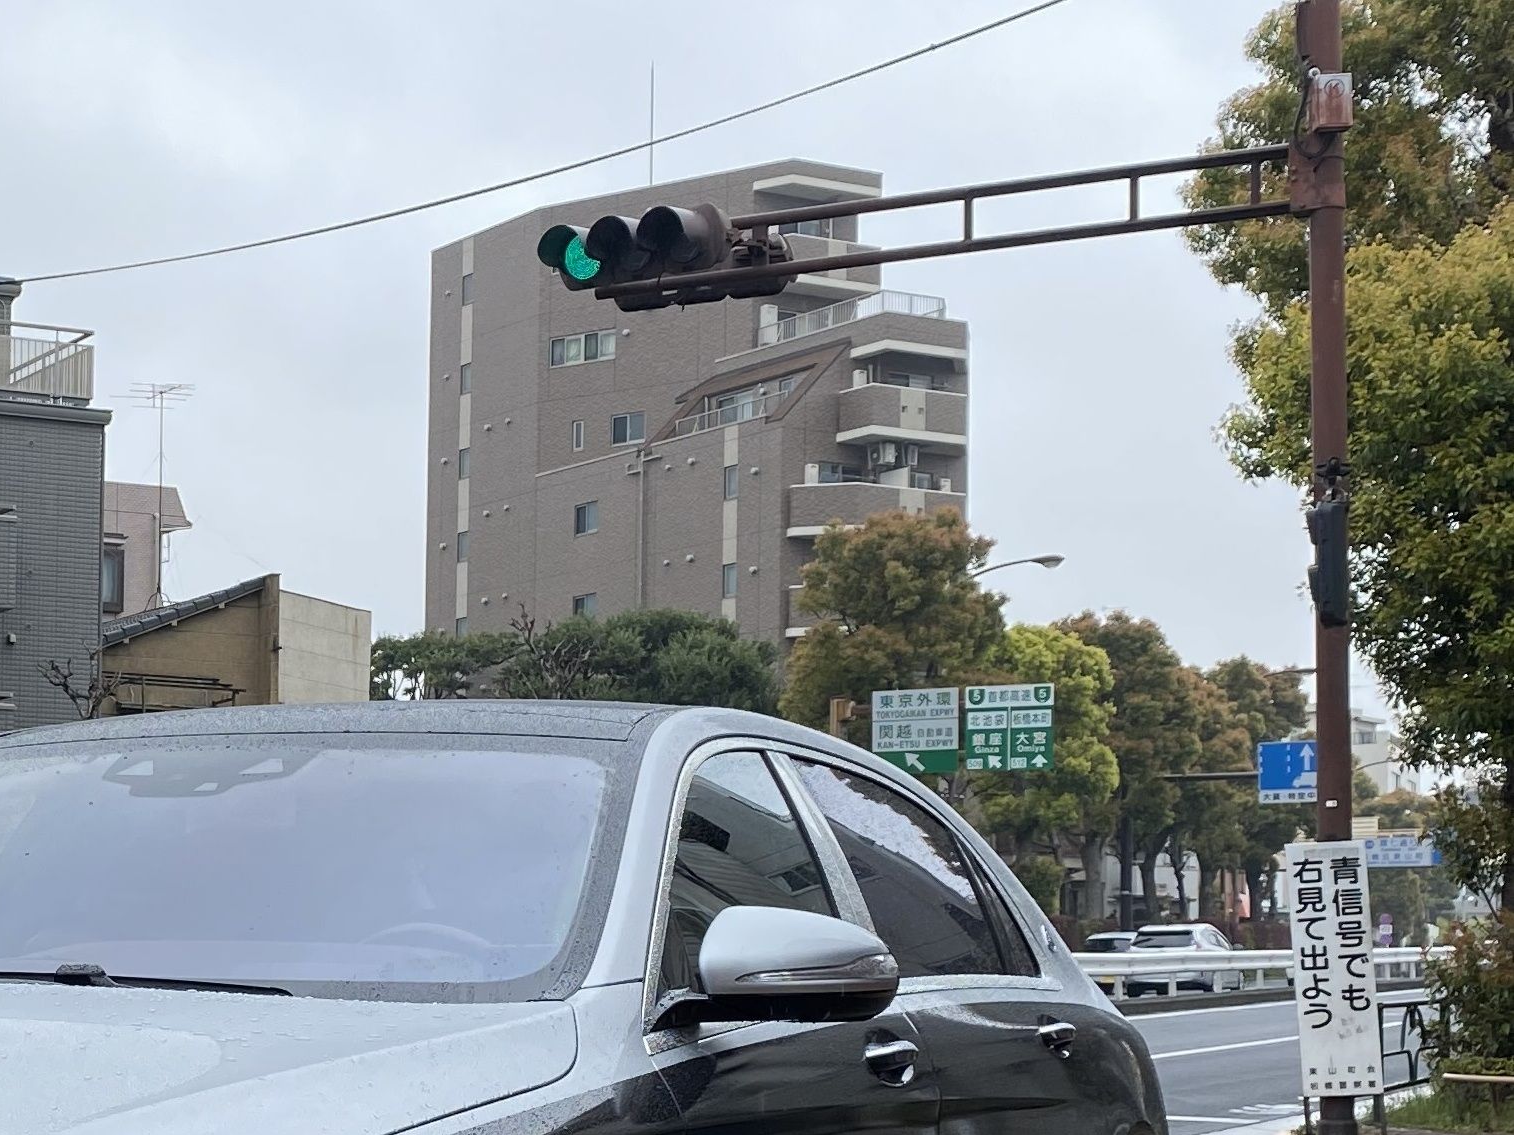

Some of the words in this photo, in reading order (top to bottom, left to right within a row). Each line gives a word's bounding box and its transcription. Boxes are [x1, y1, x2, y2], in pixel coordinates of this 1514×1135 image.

[880, 691, 951, 709] 東京外環
[973, 689, 981, 702] 5
[988, 689, 1032, 703] 首都高速
[930, 708, 955, 717] EXPWY
[1013, 712, 1050, 725] 板橋本町
[970, 713, 1005, 727] 北池袋
[879, 724, 912, 740] 関越
[917, 727, 953, 738] 自動車道
[972, 732, 1003, 746] 銀座
[1015, 731, 1047, 745] 大宮
[877, 740, 921, 750] KAN-ETSU
[926, 739, 954, 748] EXPWY
[974, 746, 1000, 754] Ginza
[1016, 744, 1046, 753] Omiya
[1329, 856, 1371, 1012] 青信号でも
[1293, 858, 1333, 1029] 右見て出よう
[1309, 1064, 1376, 1076] 東山町会
